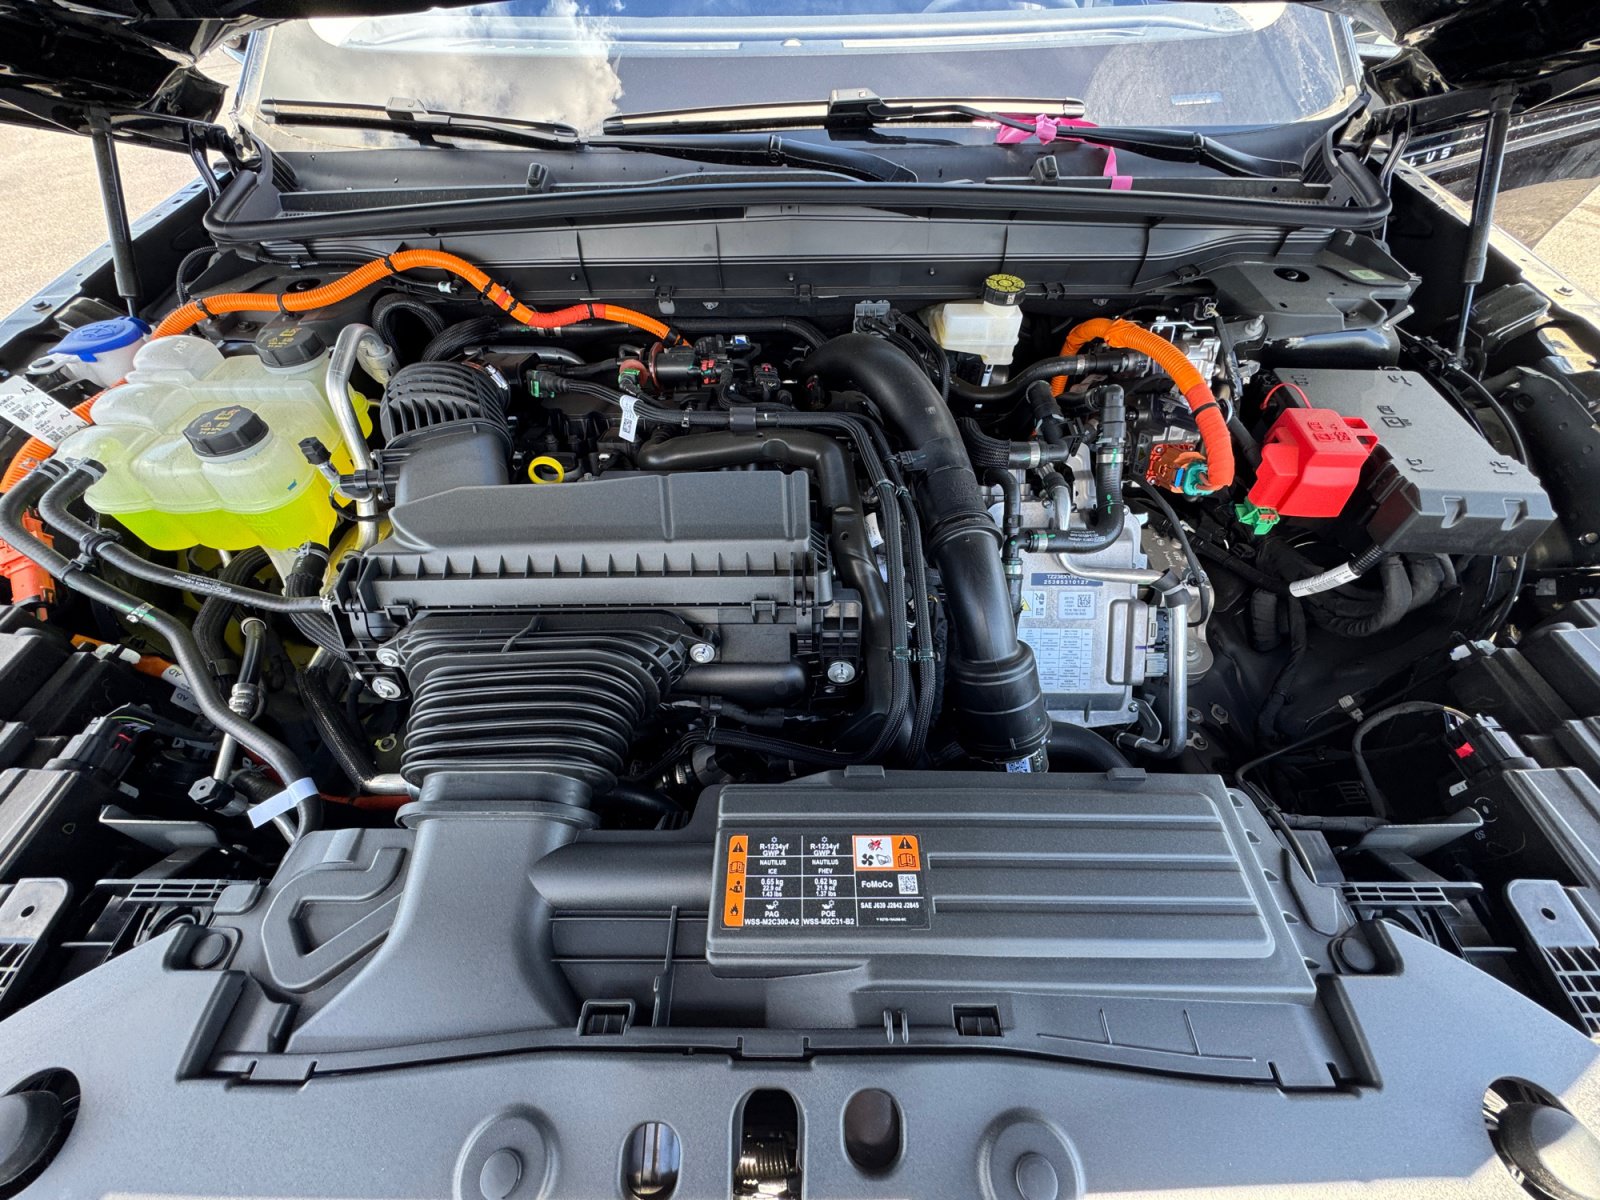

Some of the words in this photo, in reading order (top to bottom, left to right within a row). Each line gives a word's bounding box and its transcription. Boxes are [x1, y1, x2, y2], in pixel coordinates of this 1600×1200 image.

[20, 384, 34, 396] AJ
[41, 398, 55, 408] AJ
[60, 410, 71, 420] AJ
[760, 843, 789, 851] R-1234yf
[810, 843, 839, 851] R-1234yf
[776, 878, 784, 886] kg
[829, 878, 837, 886] kg
